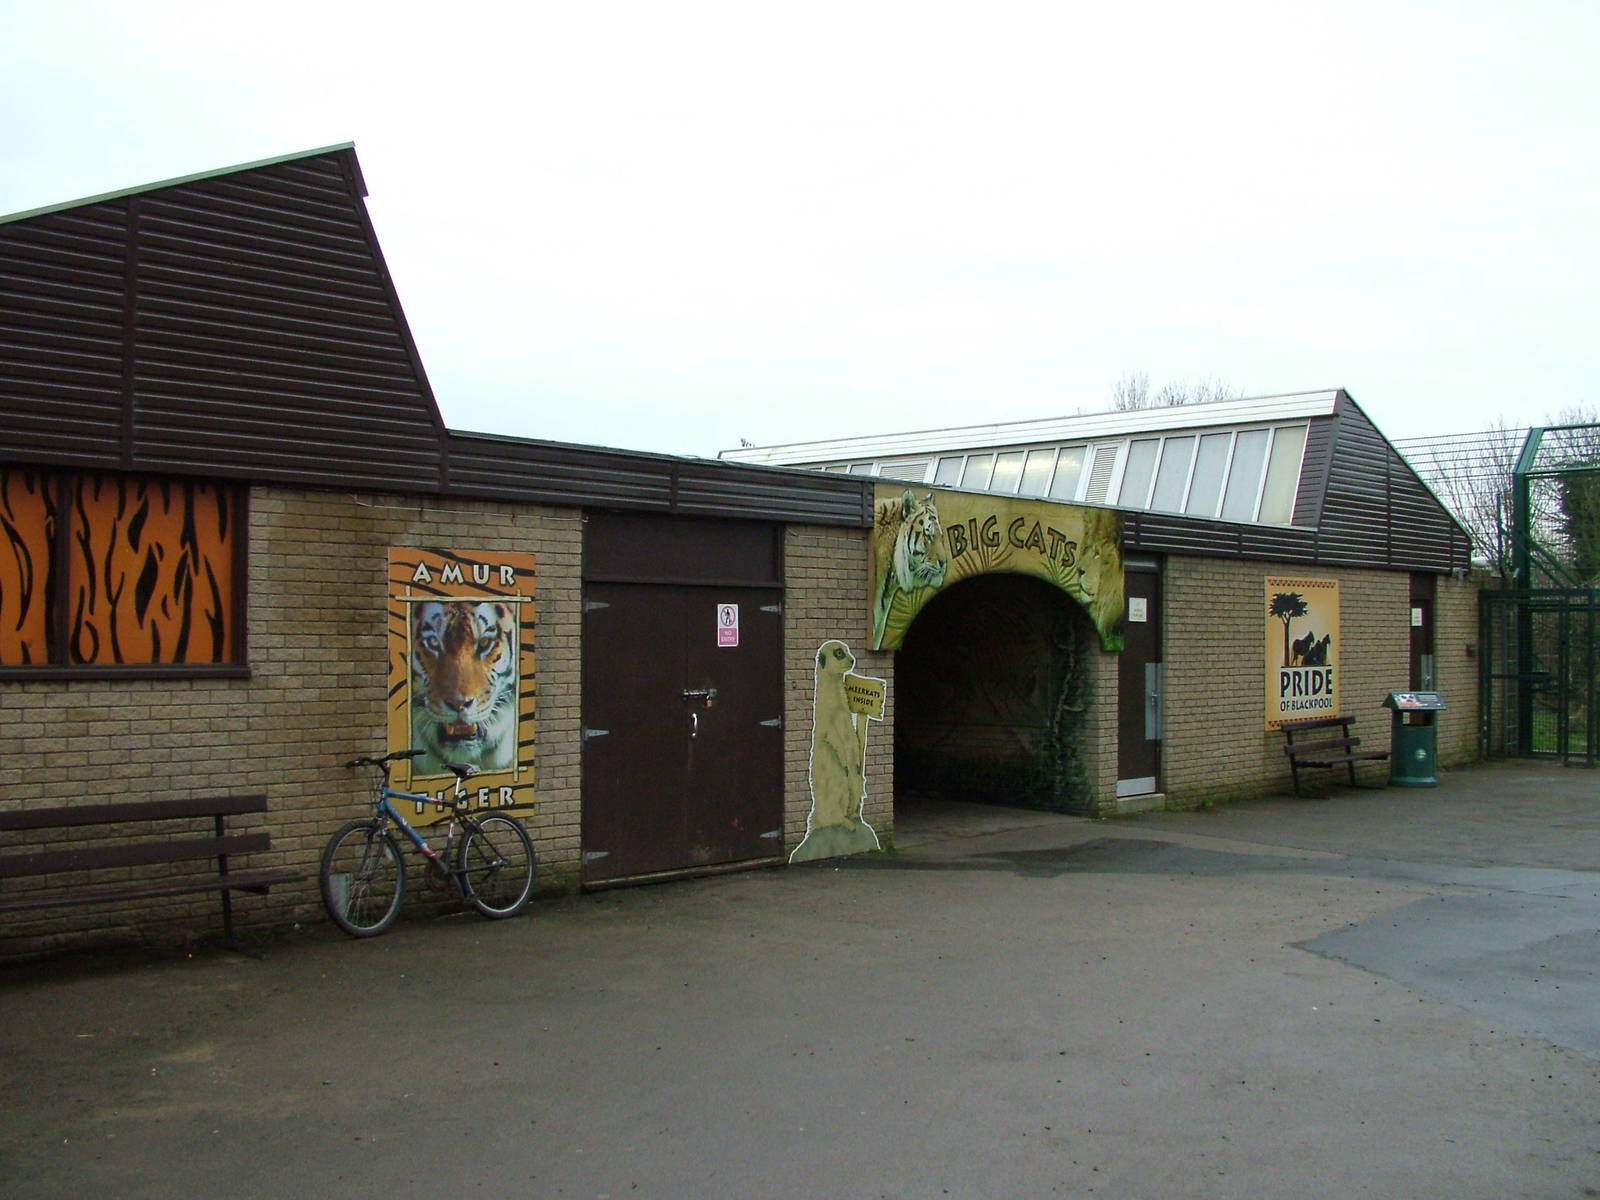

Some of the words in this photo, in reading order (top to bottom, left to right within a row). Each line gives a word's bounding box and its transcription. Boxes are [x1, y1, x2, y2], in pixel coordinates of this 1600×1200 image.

[946, 514, 1000, 559] BIG
[1008, 517, 1078, 567] CATS
[412, 561, 515, 585] AMUR
[848, 686, 880, 698] MEERKATS
[1280, 669, 1333, 697] PRIDE
[853, 696, 873, 706] INSIDE
[1280, 700, 1290, 712] OF
[1291, 697, 1333, 711] BLACKPOOL
